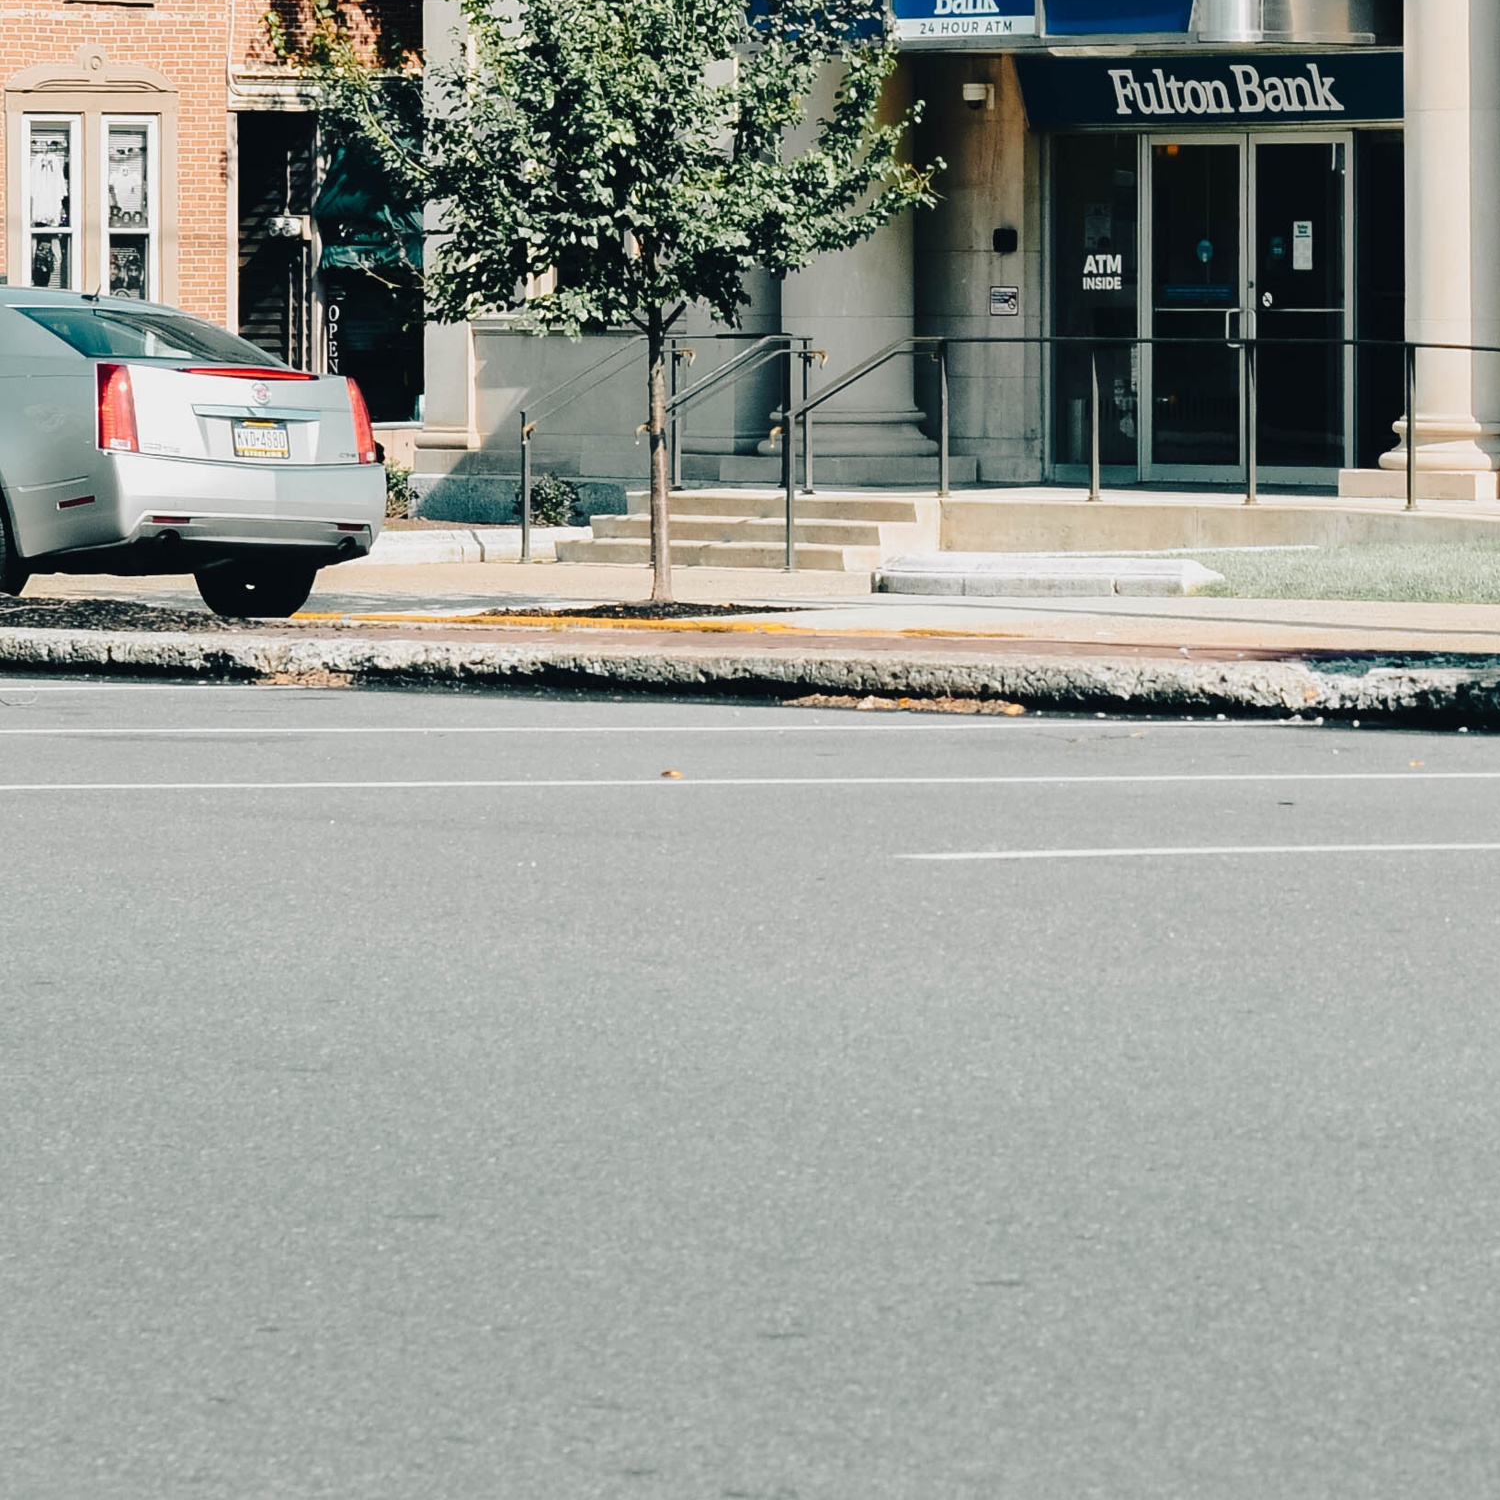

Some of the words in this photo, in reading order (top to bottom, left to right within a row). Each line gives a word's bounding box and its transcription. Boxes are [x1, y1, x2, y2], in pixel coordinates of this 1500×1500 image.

[920, 23, 935, 35] 24
[941, 22, 979, 34] HOUR
[985, 21, 1013, 33] ATM
[1107, 68, 1235, 115] Fulton
[1230, 62, 1345, 114] Bank
[1083, 254, 1122, 274] ATM
[1082, 277, 1122, 290] INSIDE
[328, 304, 340, 375] OPEN
